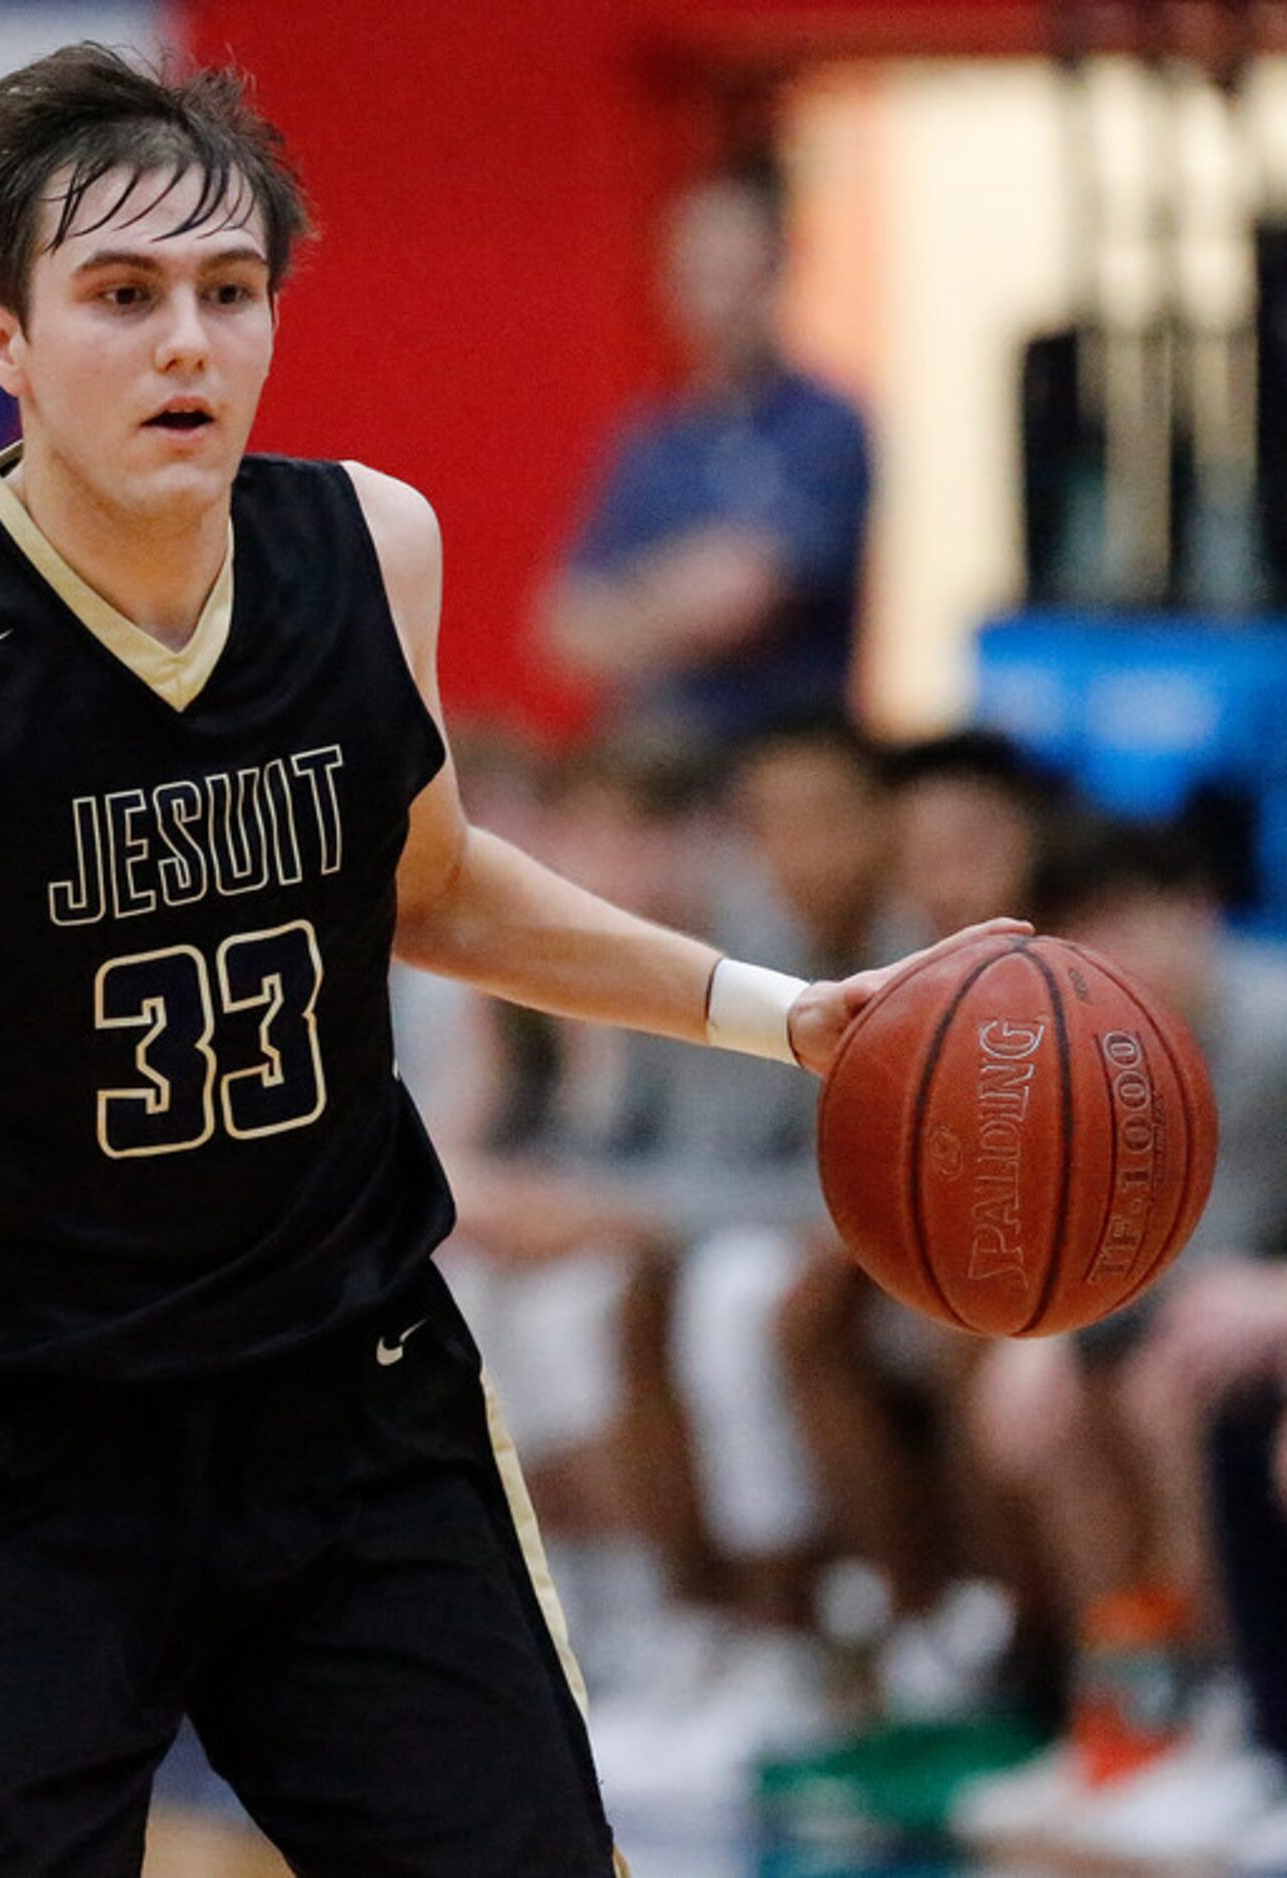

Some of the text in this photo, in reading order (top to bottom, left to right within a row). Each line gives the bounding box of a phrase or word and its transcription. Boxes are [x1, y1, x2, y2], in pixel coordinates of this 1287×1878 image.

[48, 744, 344, 926] JESUIT
[95, 919, 327, 1158] 33
[967, 1014, 1046, 1289] SPALDING
[1088, 1030, 1153, 1286] TF-1000
